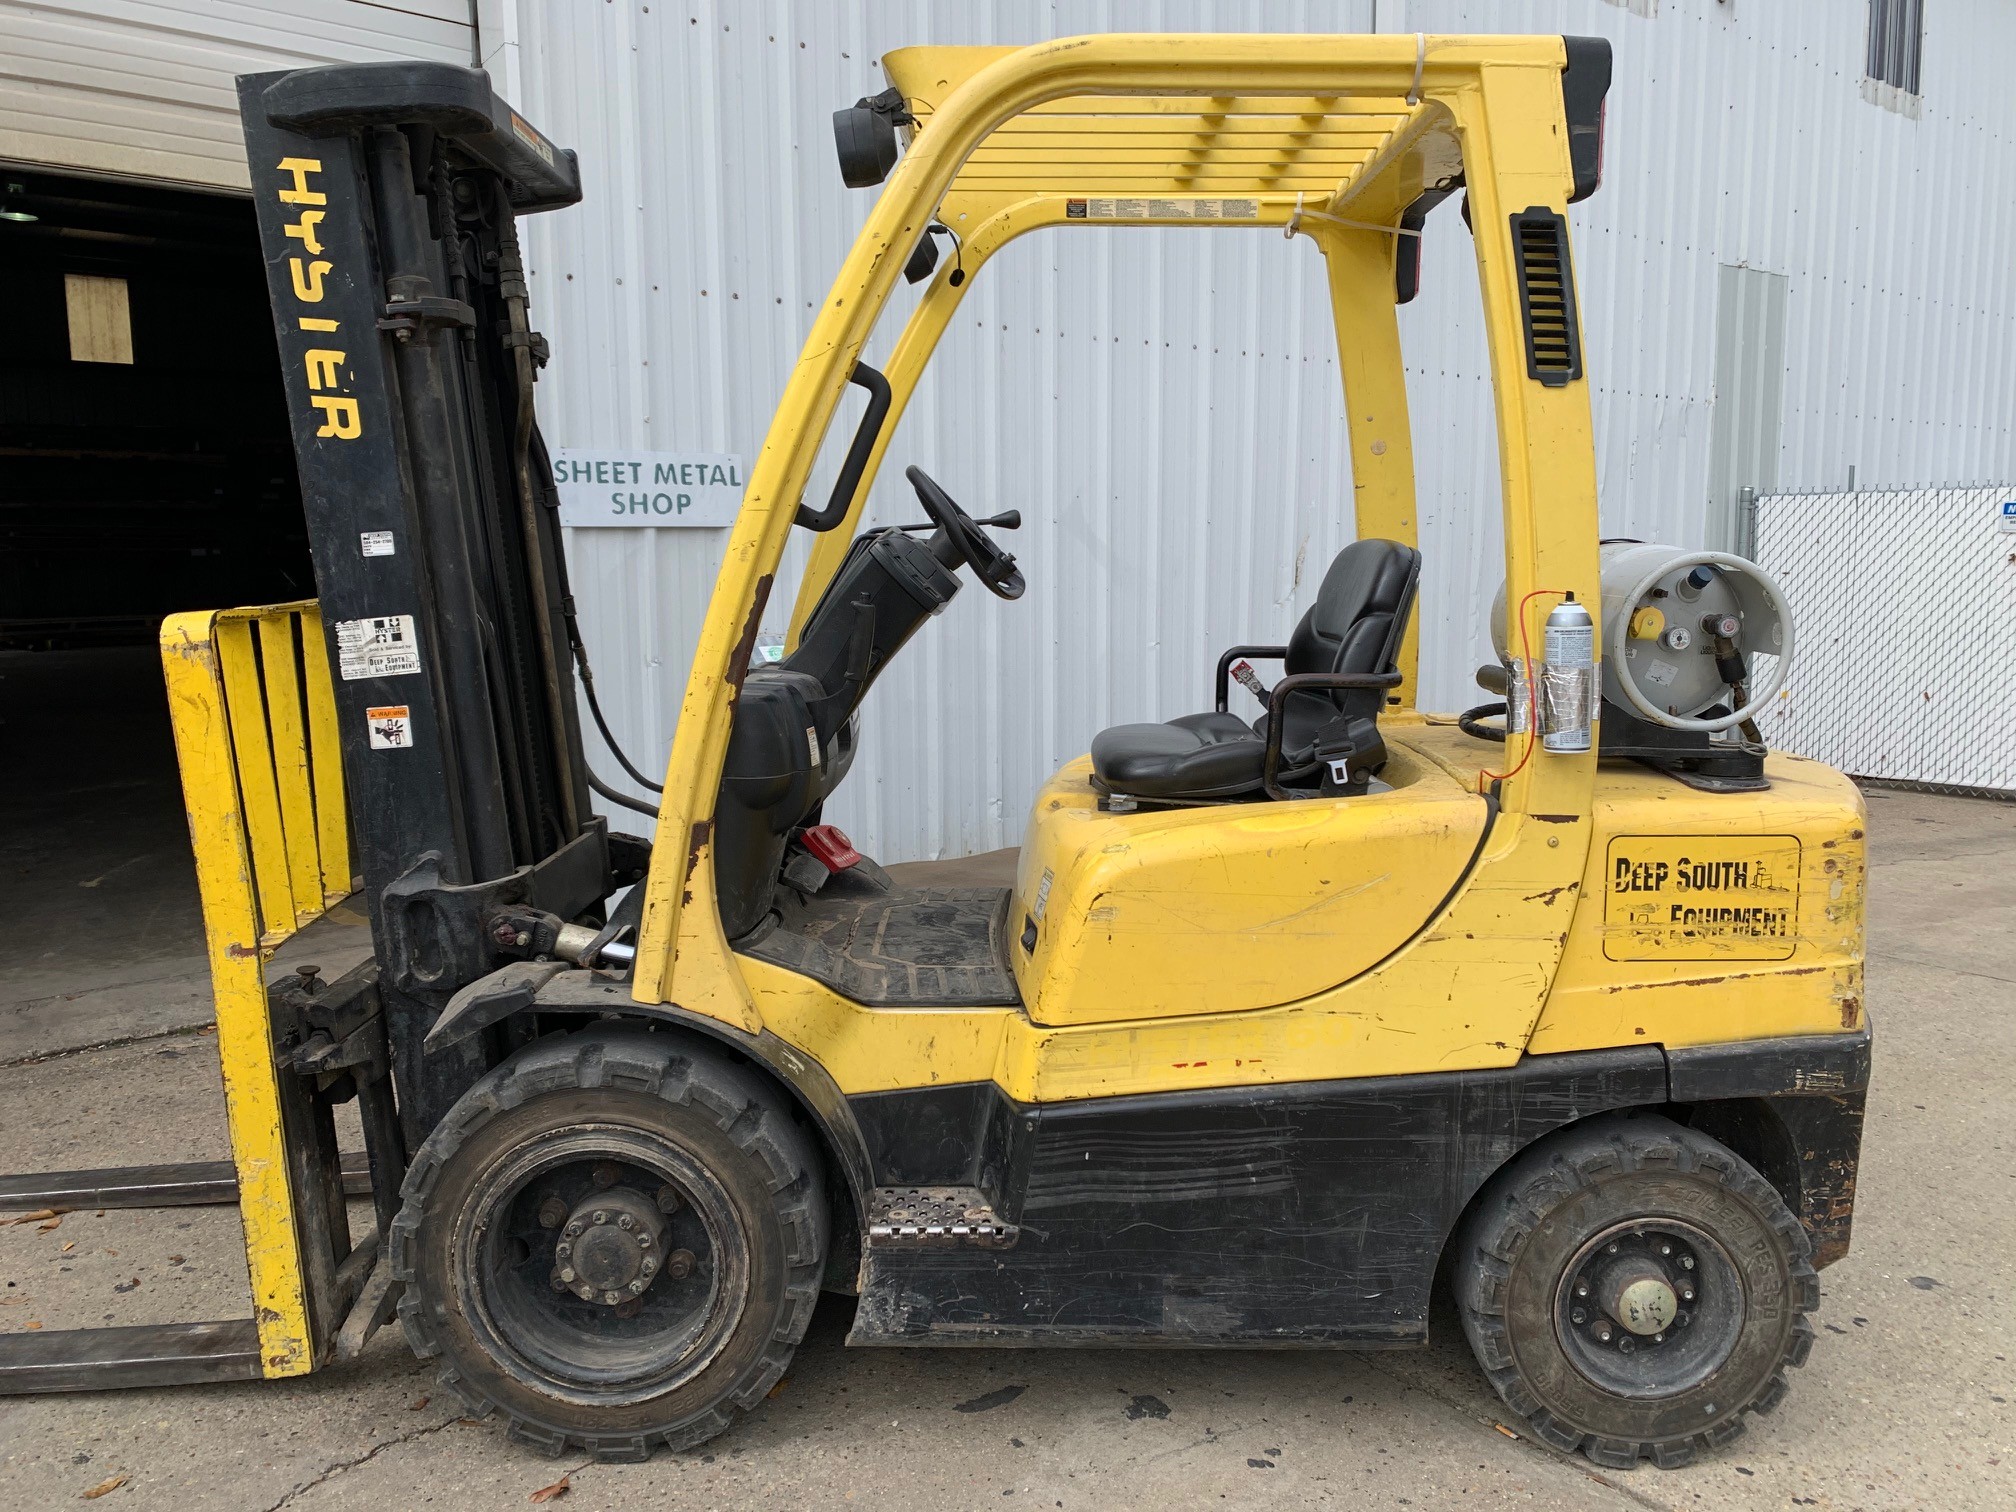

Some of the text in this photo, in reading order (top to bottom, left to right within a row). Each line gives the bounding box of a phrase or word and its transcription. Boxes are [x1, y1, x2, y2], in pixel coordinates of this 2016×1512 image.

[276, 157, 362, 439] HYSTER
[554, 460, 742, 487] SHEET METAL
[611, 492, 692, 515] SHOP
